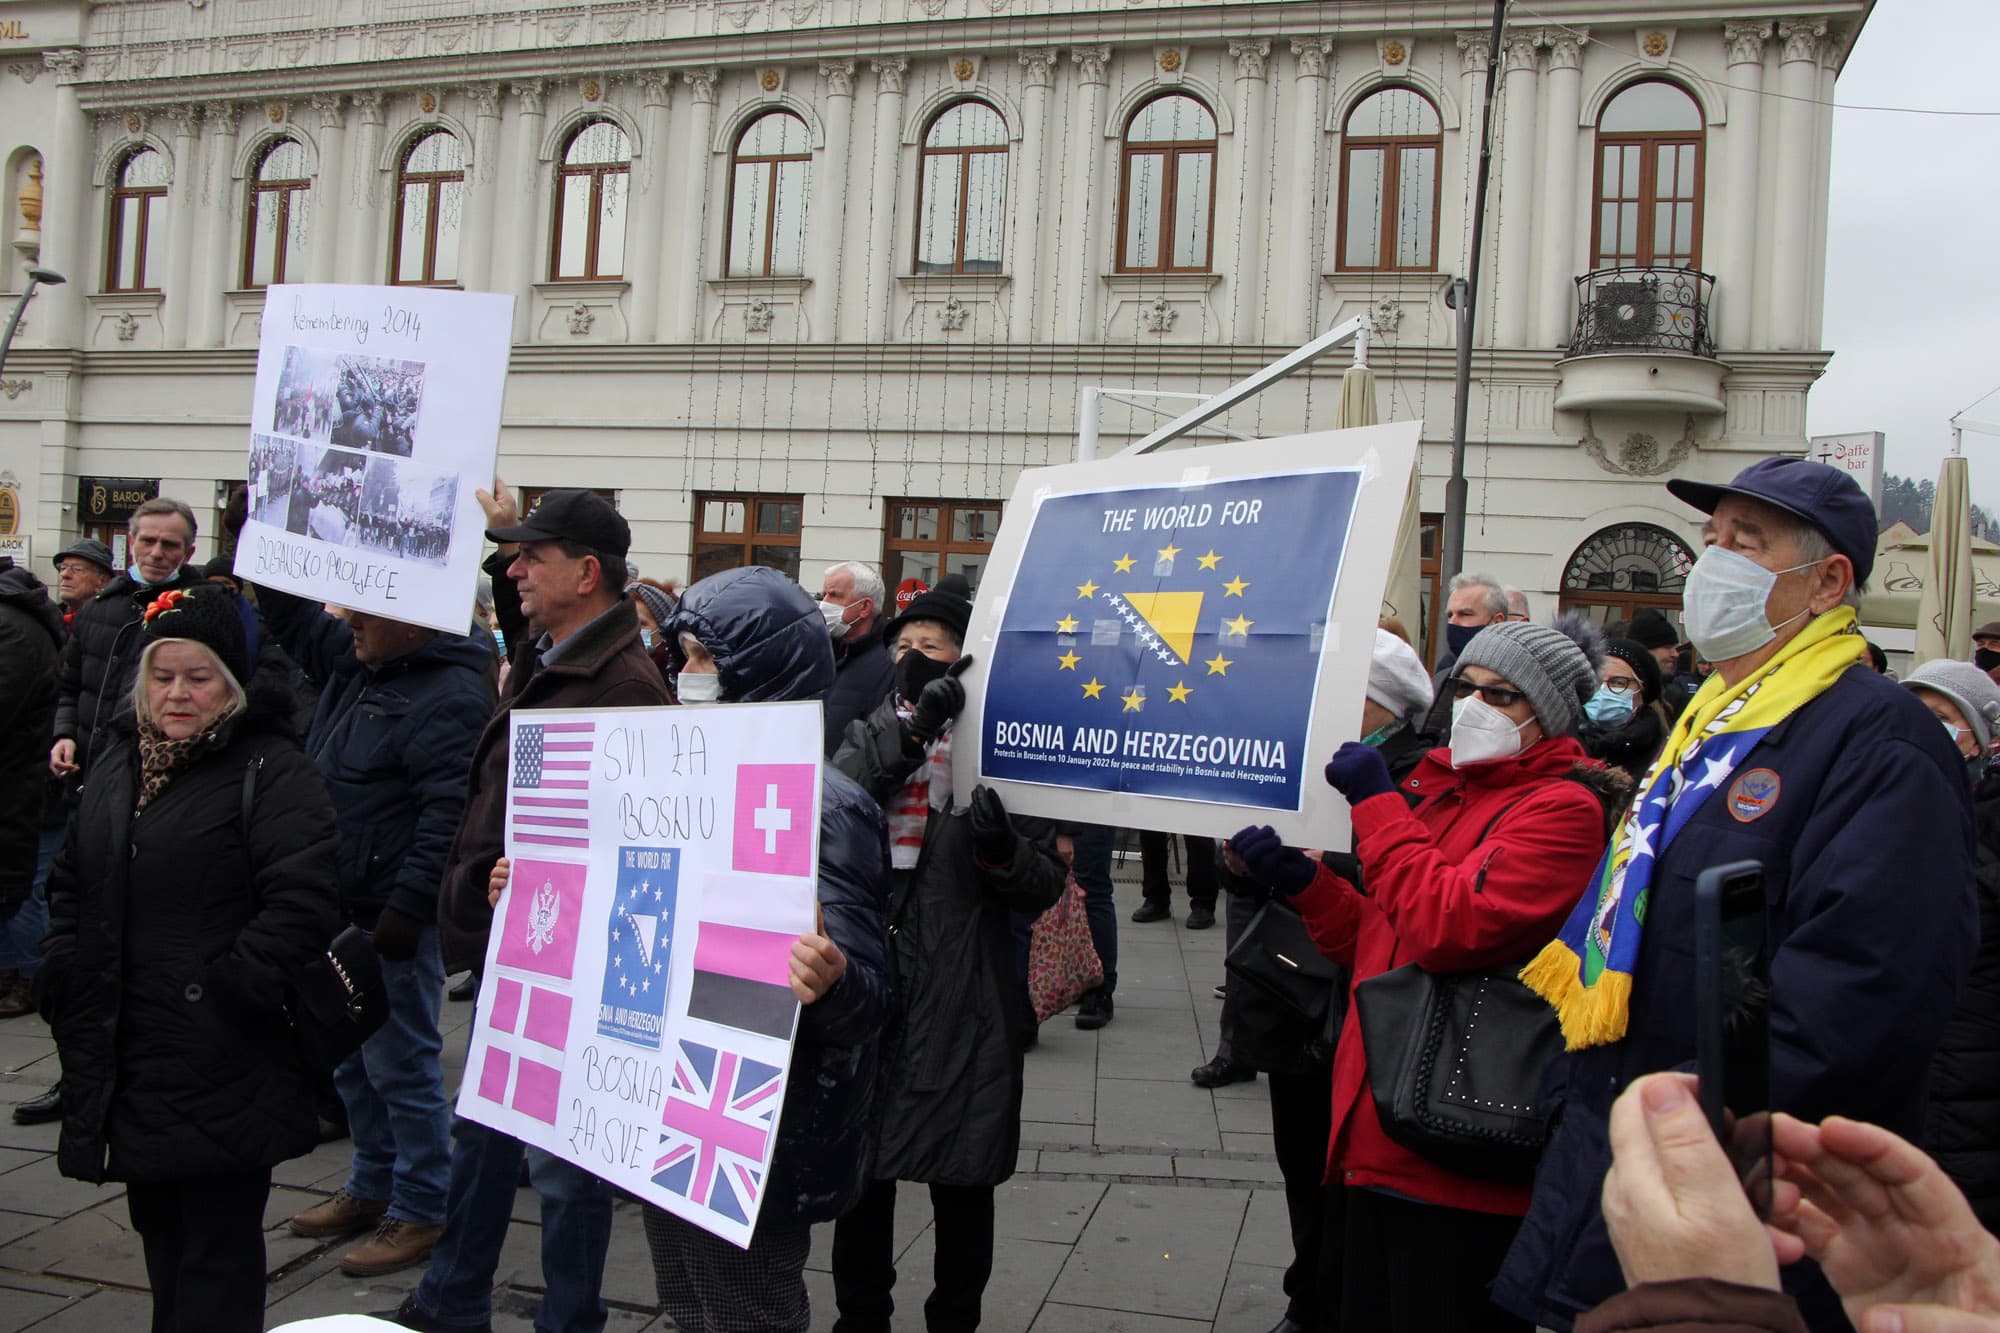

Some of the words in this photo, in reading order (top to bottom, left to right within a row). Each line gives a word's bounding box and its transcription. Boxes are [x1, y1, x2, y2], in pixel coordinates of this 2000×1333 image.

[381, 305, 422, 342] 2014
[1847, 458, 1867, 470] bar
[112, 491, 146, 503] BAROK
[1102, 508, 1137, 533] THE
[1143, 503, 1213, 531] WORLD
[1220, 499, 1263, 526] FOR
[604, 727, 645, 781] SVI
[995, 721, 1065, 750] BOSNIA
[1072, 727, 1118, 755] AND
[1123, 730, 1287, 769] HERZEGOVINA
[994, 747, 1016, 759] Protests
[1016, 749, 1023, 759] in
[1023, 751, 1048, 762] Brussels
[1048, 754, 1057, 762] on
[1058, 754, 1066, 763] 10
[1066, 755, 1092, 768] January
[1092, 758, 1110, 768] 2022
[1110, 758, 1120, 769] for
[1121, 761, 1141, 770] peace
[1141, 760, 1155, 771] and
[1156, 763, 1185, 776] stability
[1186, 766, 1193, 775] in
[1194, 767, 1220, 778] Bosnia
[1221, 769, 1236, 779] and
[1237, 770, 1287, 785] Herzegovina
[619, 792, 715, 841] BOSNU
[637, 851, 659, 870] WORLD
[614, 1007, 628, 1026] AND
[582, 1045, 662, 1111] BOSNA
[602, 1117, 649, 1169] SVE
